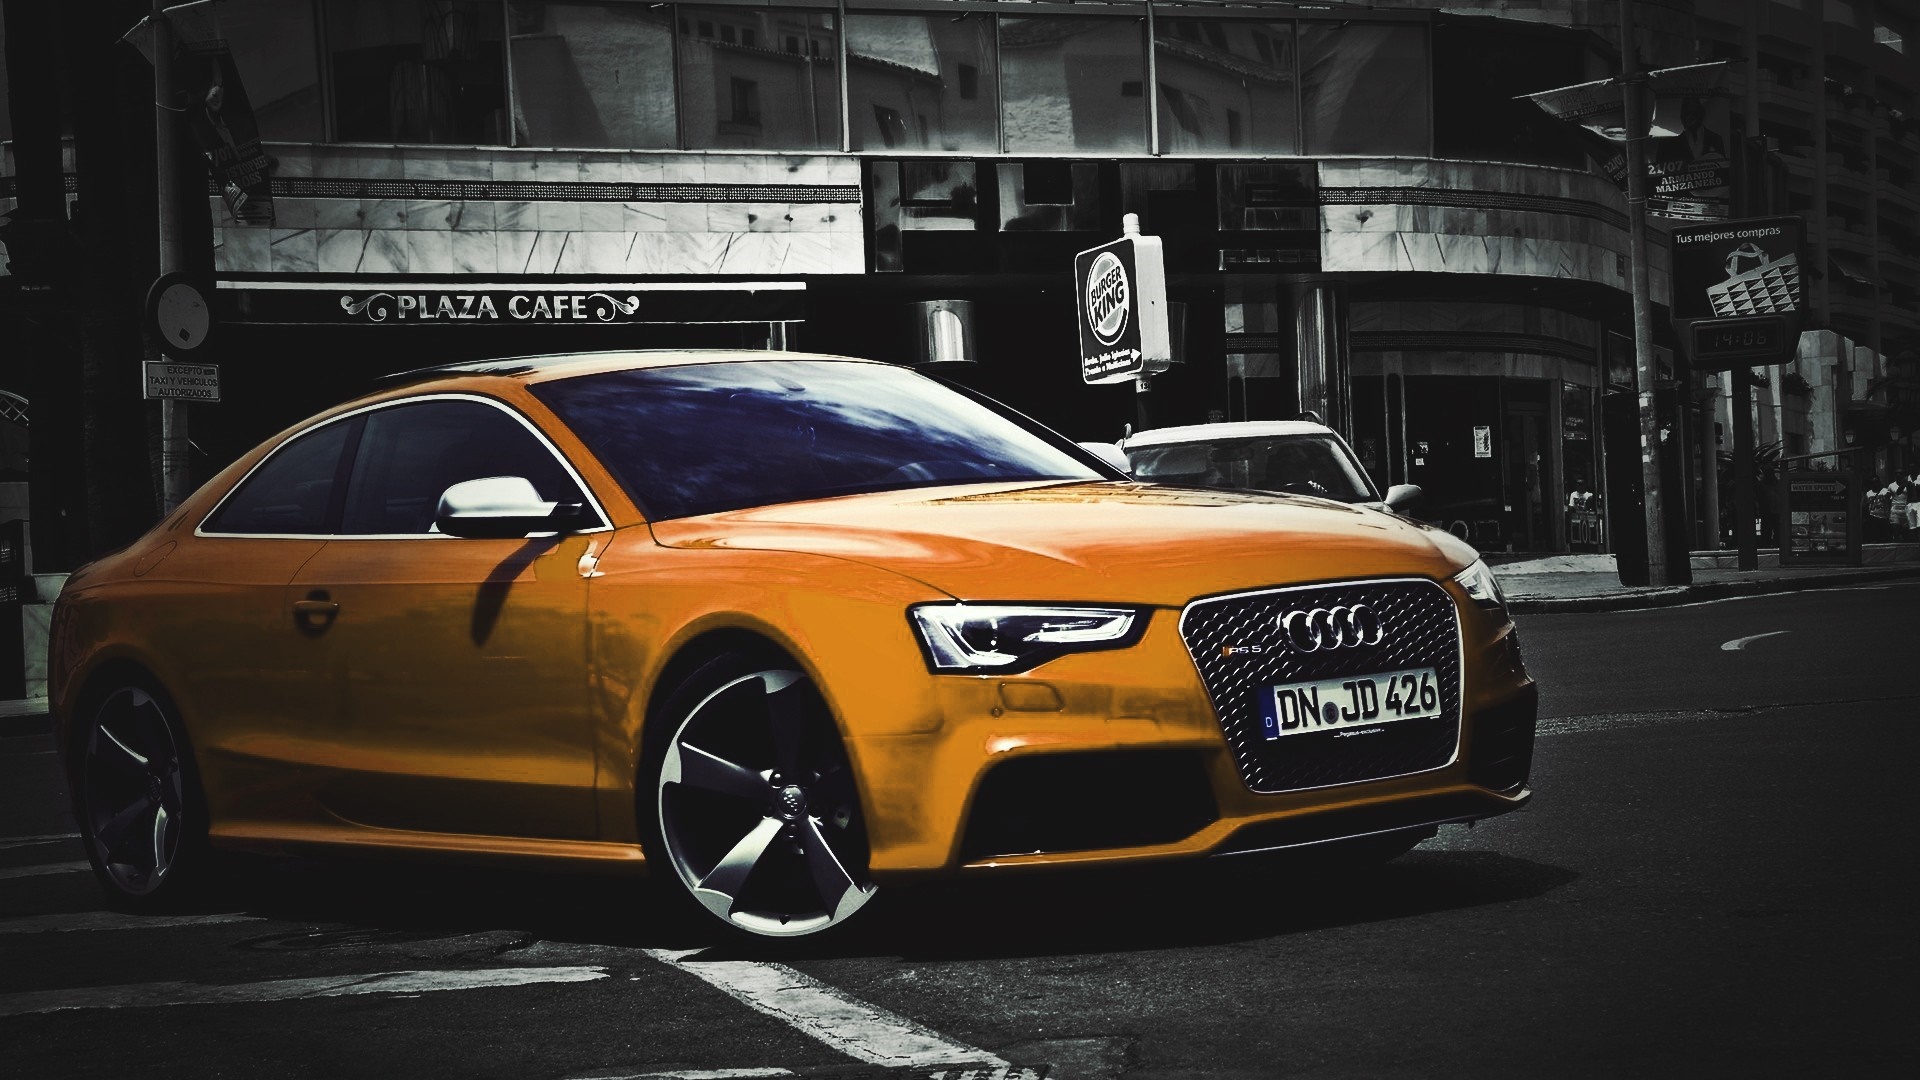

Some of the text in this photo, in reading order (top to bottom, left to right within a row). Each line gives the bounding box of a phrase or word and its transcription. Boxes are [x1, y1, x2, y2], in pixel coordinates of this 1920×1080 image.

[1648, 160, 1683, 175] 21/07
[1656, 177, 1722, 193] MANZANERO
[1661, 171, 1715, 185] ARMANDO
[1676, 226, 1781, 243] Tus mejores compras
[1091, 265, 1122, 307] BURGER
[397, 295, 588, 319] PLAZA CAFE
[1093, 280, 1125, 329] KING
[167, 366, 202, 375] EXCEPTO
[149, 376, 218, 387] TAXI Y VEHICULOS
[158, 387, 212, 397] AUTORIZADOS
[1277, 672, 1437, 730] DN JD 426
[1265, 716, 1273, 728] D
